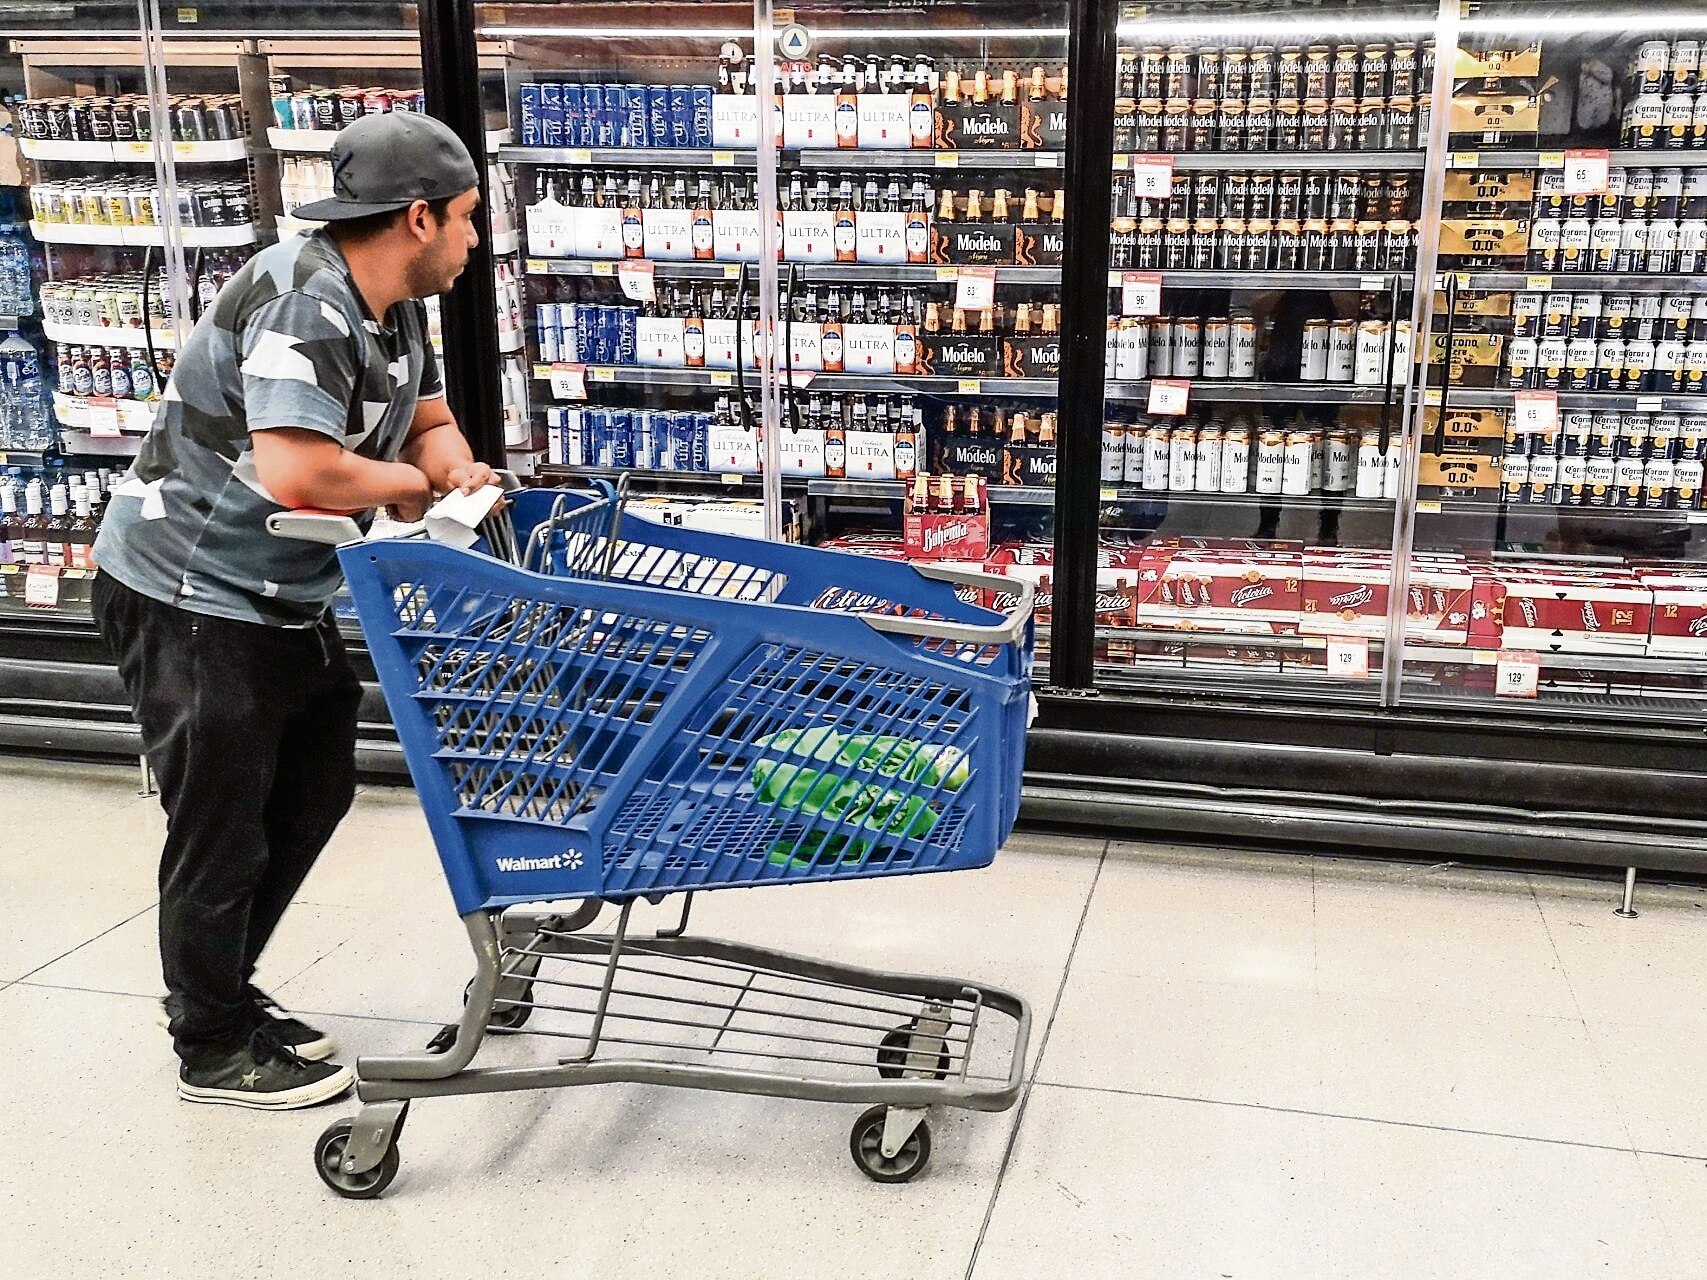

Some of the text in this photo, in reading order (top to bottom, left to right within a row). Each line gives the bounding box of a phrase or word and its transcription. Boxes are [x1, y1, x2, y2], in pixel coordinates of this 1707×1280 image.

[780, 62, 812, 72] ALTO
[716, 111, 757, 122] ULTRA
[789, 112, 830, 122] ULTRA
[863, 112, 904, 122] ULTRA
[963, 117, 1008, 135] Modelo
[1576, 170, 1586, 180] 65
[648, 225, 687, 235] ULTRA
[718, 226, 759, 236] ULTRA
[789, 228, 829, 237] ULTRA
[860, 229, 900, 238] ULTRA
[957, 234, 1001, 251] Modelo
[640, 333, 680, 343] ULTRA
[1435, 334, 1479, 348] Crona
[849, 340, 889, 350] ULTRA
[942, 346, 986, 363] Modelo
[713, 441, 752, 451] ULTRA
[850, 446, 889, 457] ULTRA
[957, 447, 997, 464] Modelo
[923, 521, 968, 552] Bohemia
[1285, 579, 1298, 592] 12
[1230, 582, 1273, 607] Victoria
[1329, 585, 1373, 609] Victoria
[1665, 605, 1678, 617] 12
[1340, 654, 1352, 663] 129
[496, 855, 562, 872] Walmart
